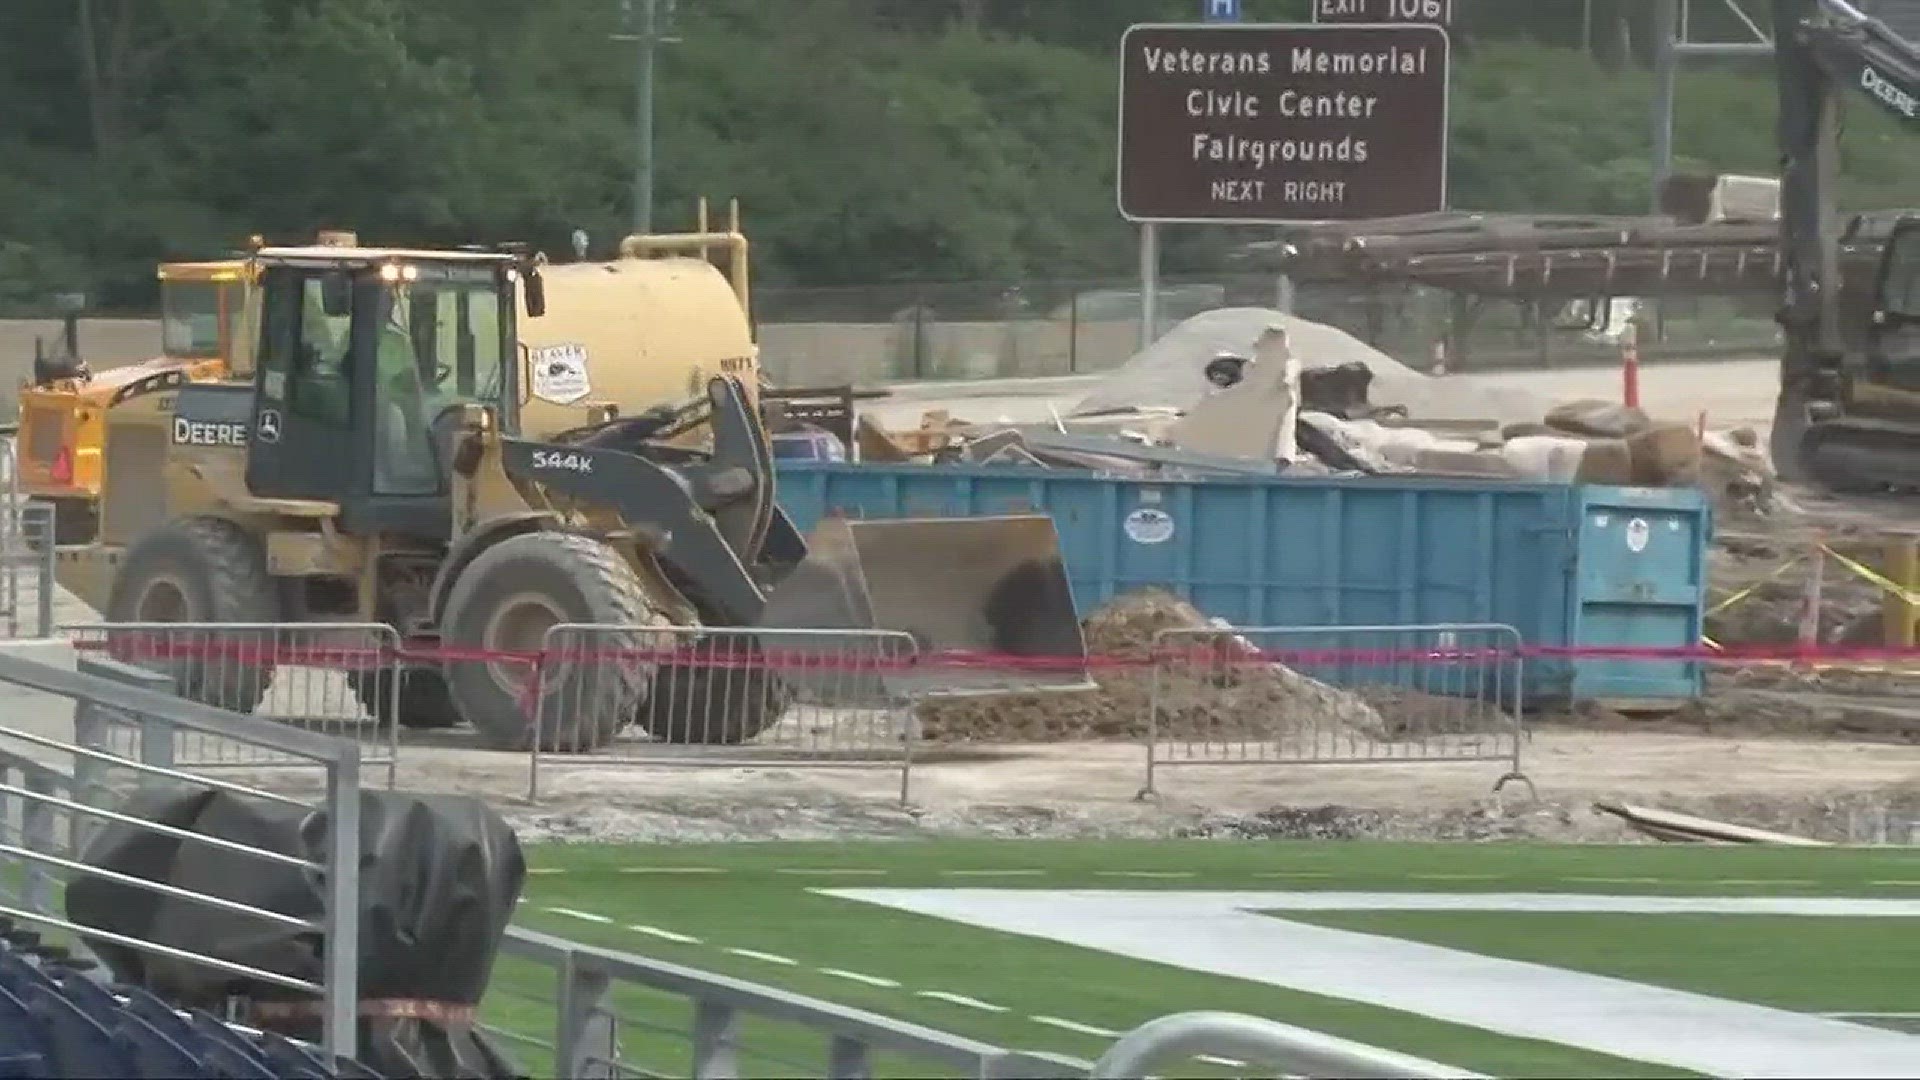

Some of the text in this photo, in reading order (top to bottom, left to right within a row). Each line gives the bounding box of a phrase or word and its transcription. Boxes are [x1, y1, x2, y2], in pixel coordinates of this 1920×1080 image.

[1143, 46, 1427, 74] Veterans Memorial
[1186, 89, 1378, 117] Civic Center
[1861, 66, 1918, 117] DEERE
[1192, 133, 1369, 169] Fairgrounds
[1211, 180, 1346, 202] NEXT RIGHT
[174, 417, 247, 446] DEERE
[532, 451, 593, 473] 544K
